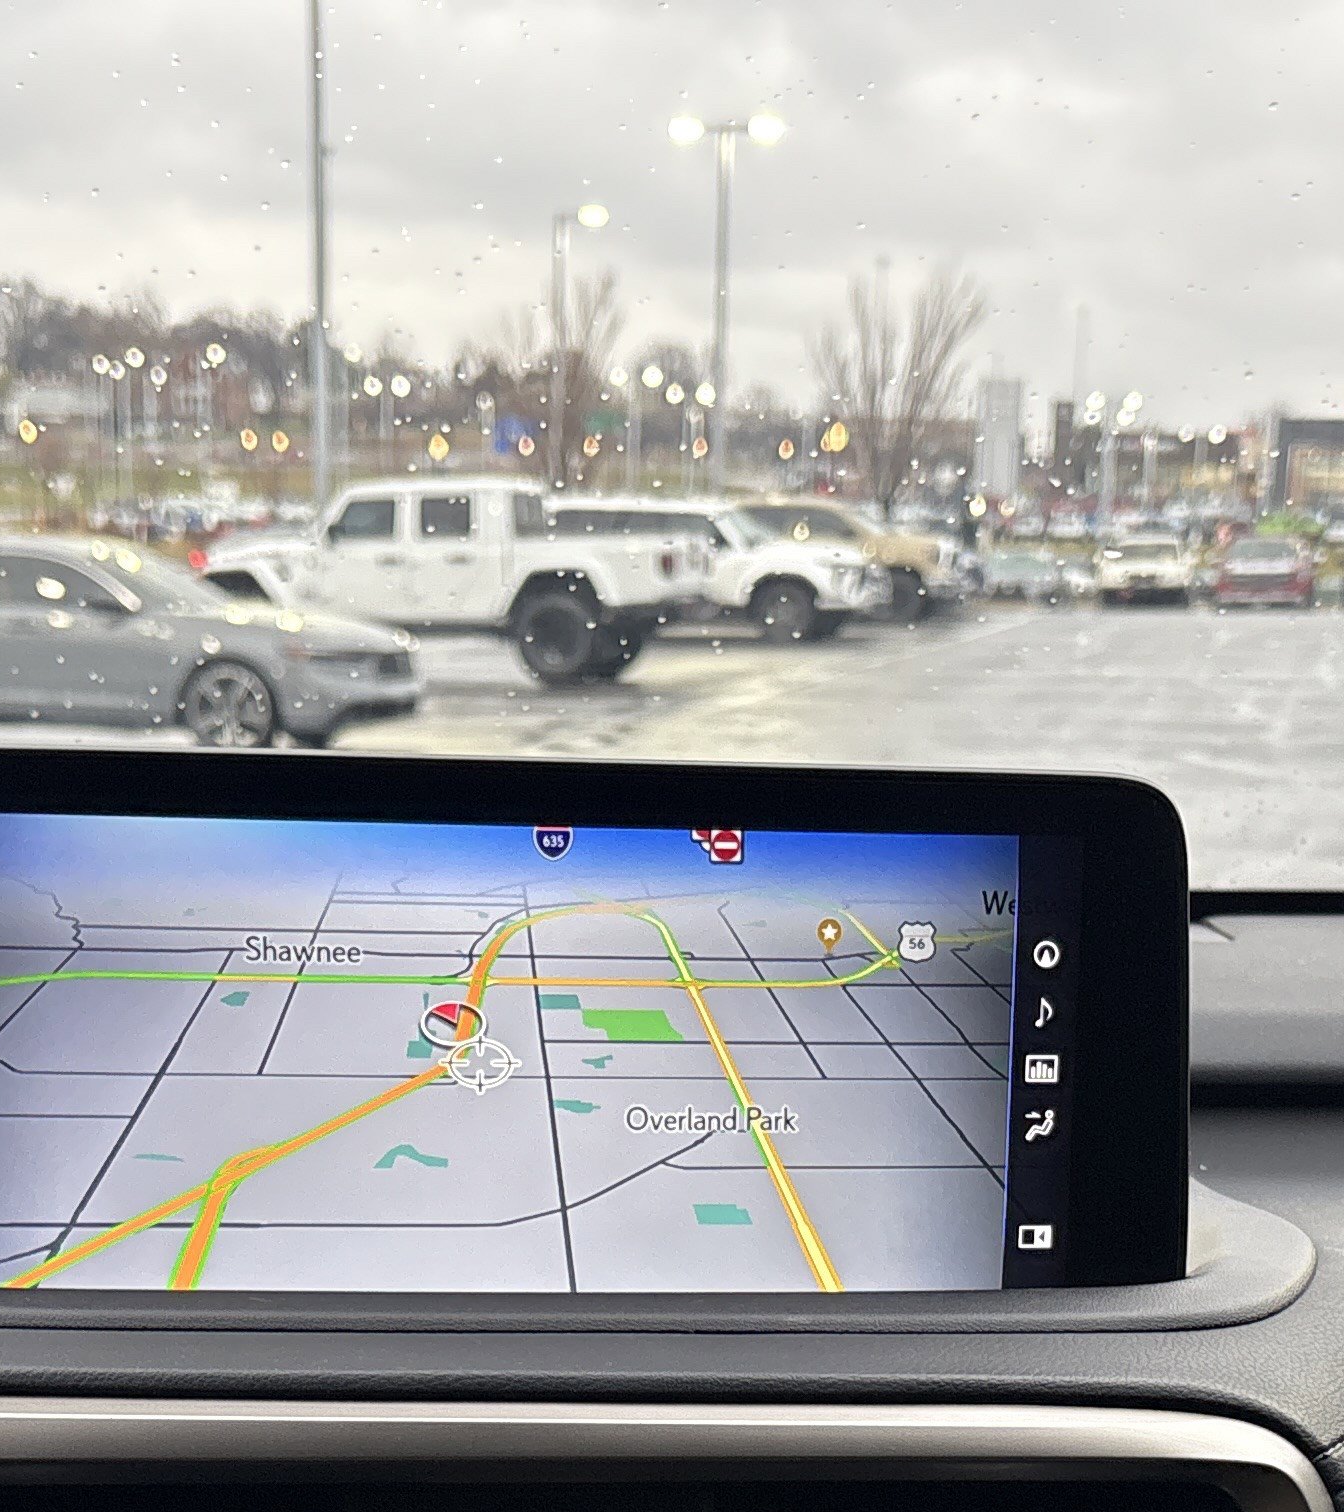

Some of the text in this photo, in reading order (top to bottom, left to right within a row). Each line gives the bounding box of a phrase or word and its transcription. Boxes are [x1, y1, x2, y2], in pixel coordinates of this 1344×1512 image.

[541, 833, 566, 849] 635
[245, 935, 362, 965] Shawnee
[908, 936, 926, 952] 56
[626, 1105, 797, 1132] Overland Park
